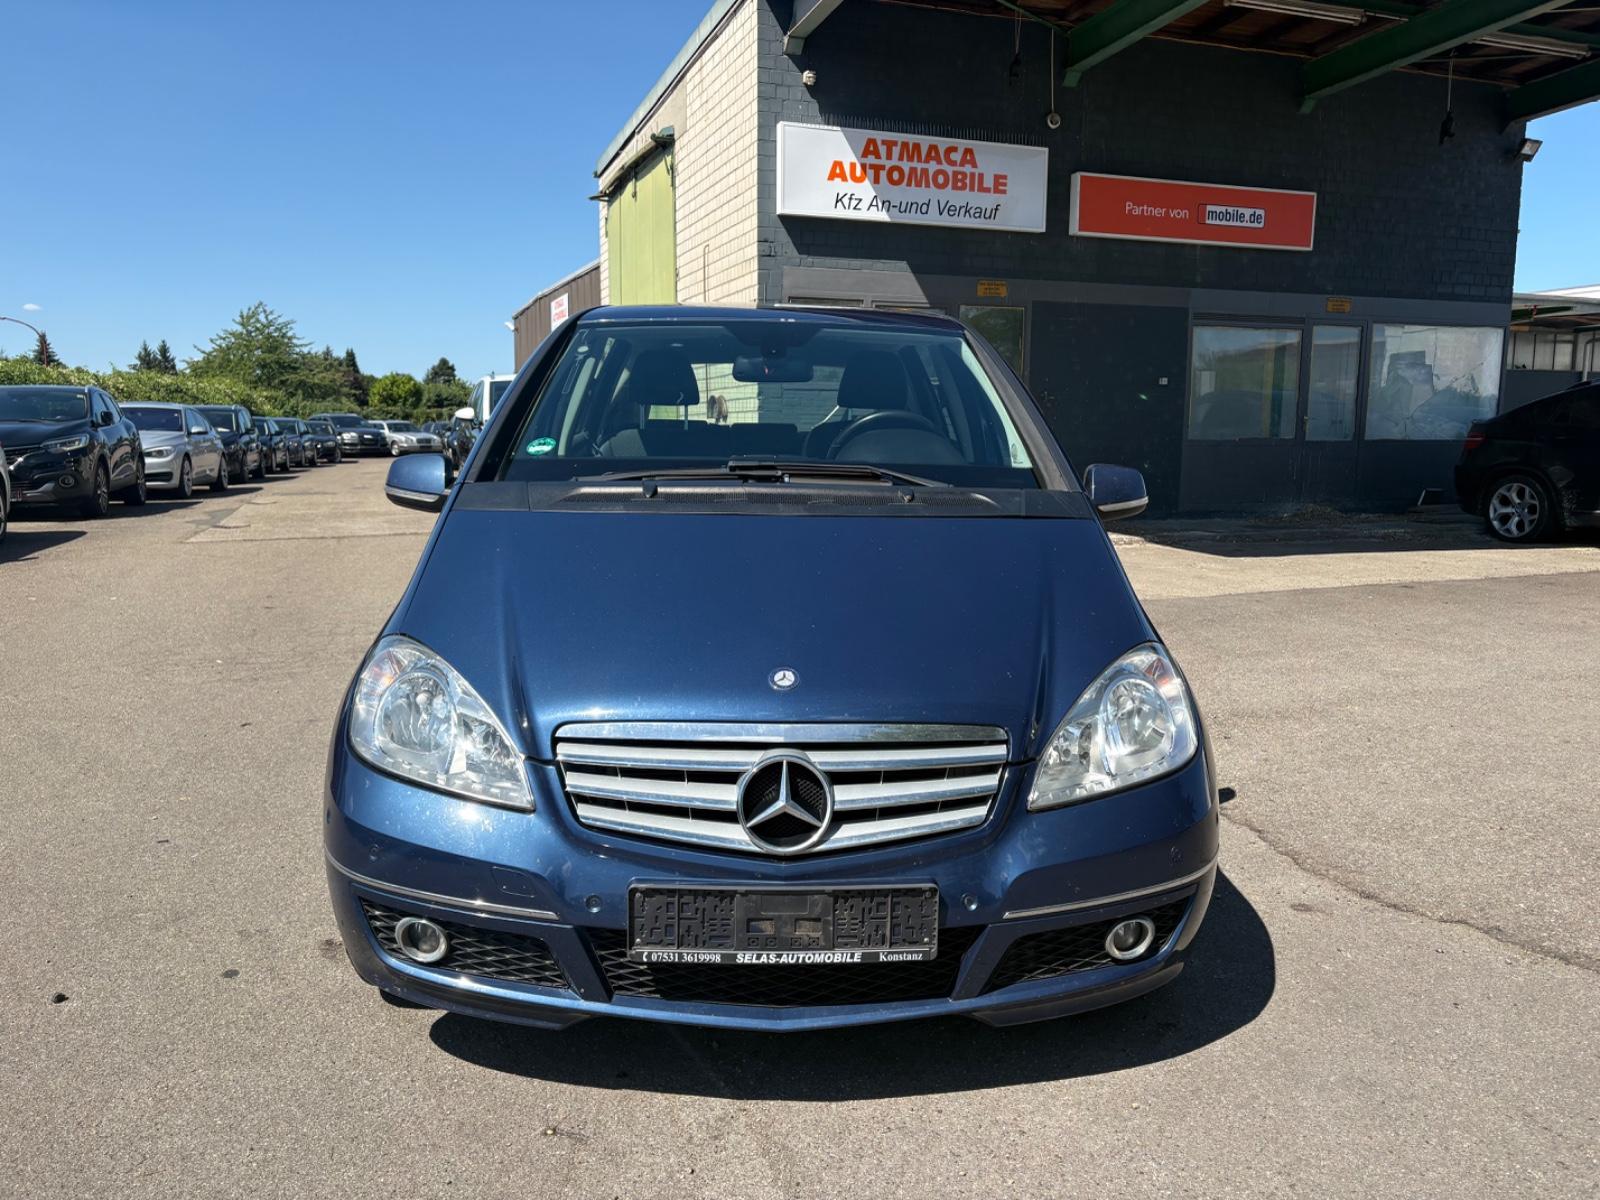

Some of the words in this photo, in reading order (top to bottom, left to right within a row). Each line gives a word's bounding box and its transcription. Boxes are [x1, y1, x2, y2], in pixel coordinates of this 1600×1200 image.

[861, 137, 979, 169] ATMACA
[827, 160, 1008, 195] AUTOMOBILE
[834, 192, 863, 211] Kfz
[867, 194, 930, 215] An-und
[937, 199, 1002, 221] Verkauf
[1125, 201, 1166, 218] Partner
[1169, 208, 1190, 219] von
[1207, 209, 1264, 225] mobile.de
[651, 952, 679, 962] 07531
[681, 952, 721, 963] 3619998
[735, 952, 863, 964] SELAS-AUTOMOBILE
[879, 951, 923, 962] Konstanz
